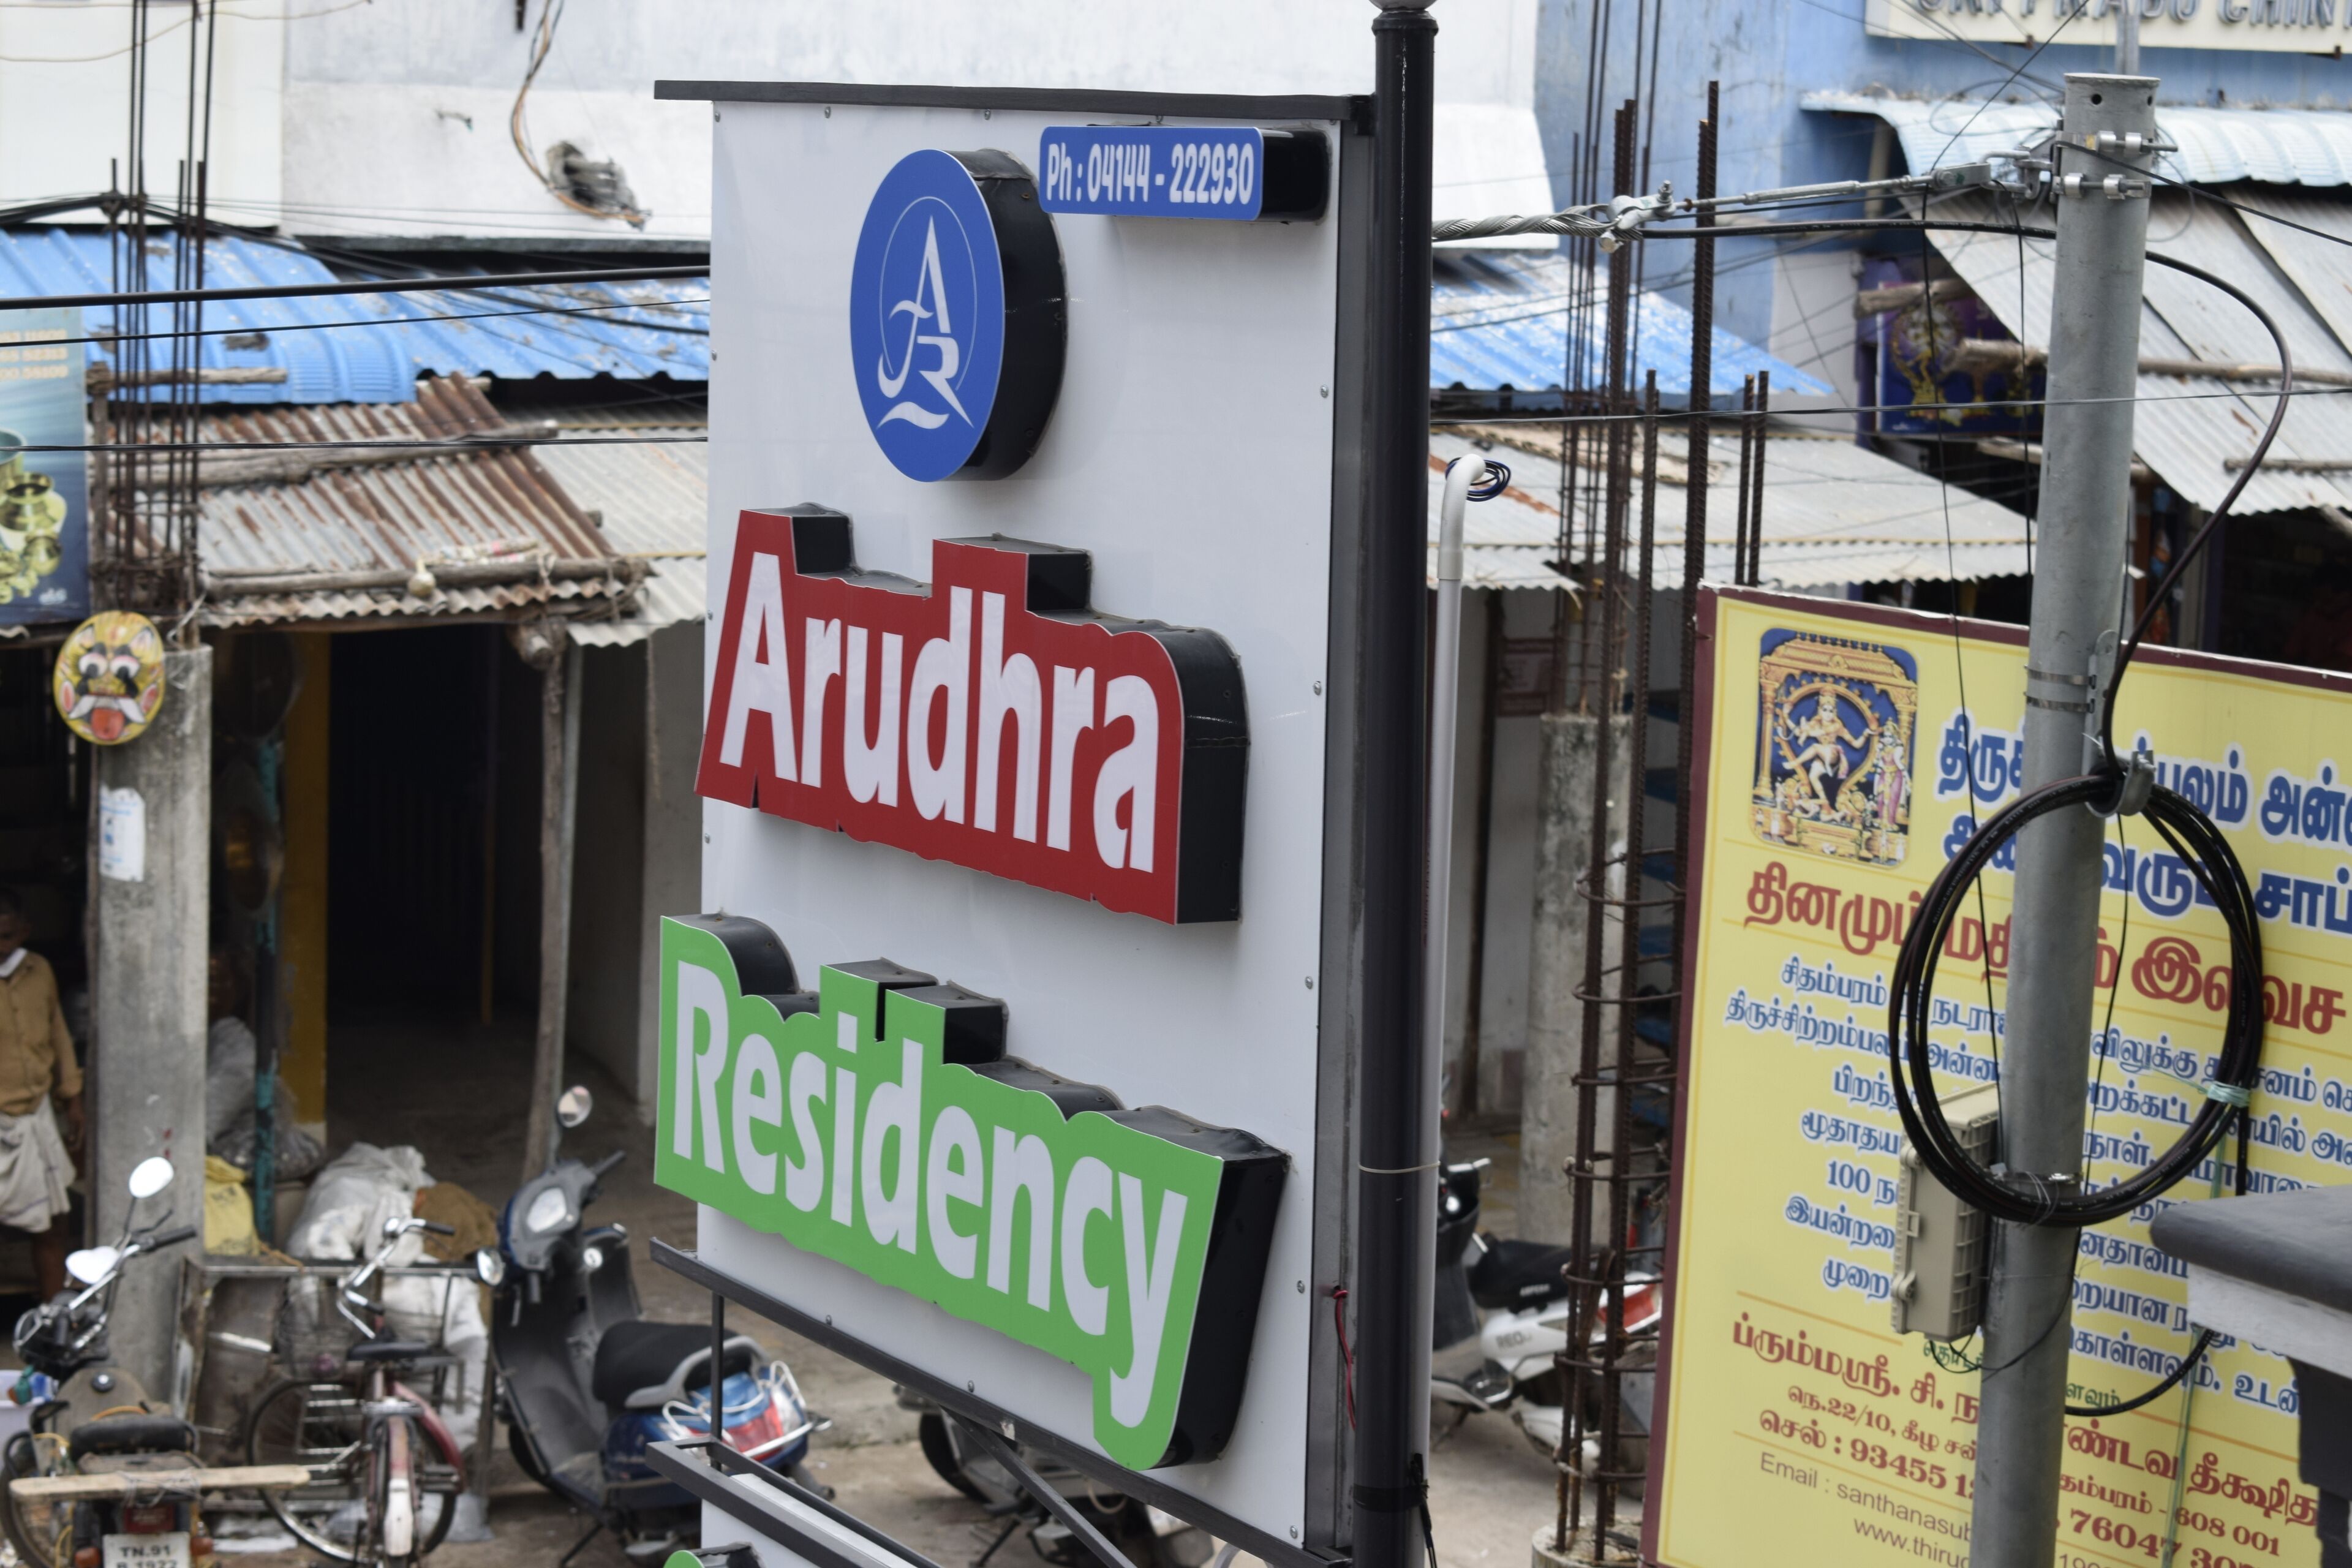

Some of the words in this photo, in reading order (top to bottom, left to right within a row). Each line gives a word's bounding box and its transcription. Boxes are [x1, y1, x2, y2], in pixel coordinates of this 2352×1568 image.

[1169, 143, 1254, 205] 222930
[719, 551, 1159, 873] Arudhra
[673, 959, 1189, 1428] Residency
[1828, 1161, 1871, 1193] 100
[1759, 1408, 1826, 1449] செல்
[1850, 1437, 1947, 1490] 93455
[1760, 1452, 1818, 1488] Email
[2231, 1525, 2280, 1556] 001
